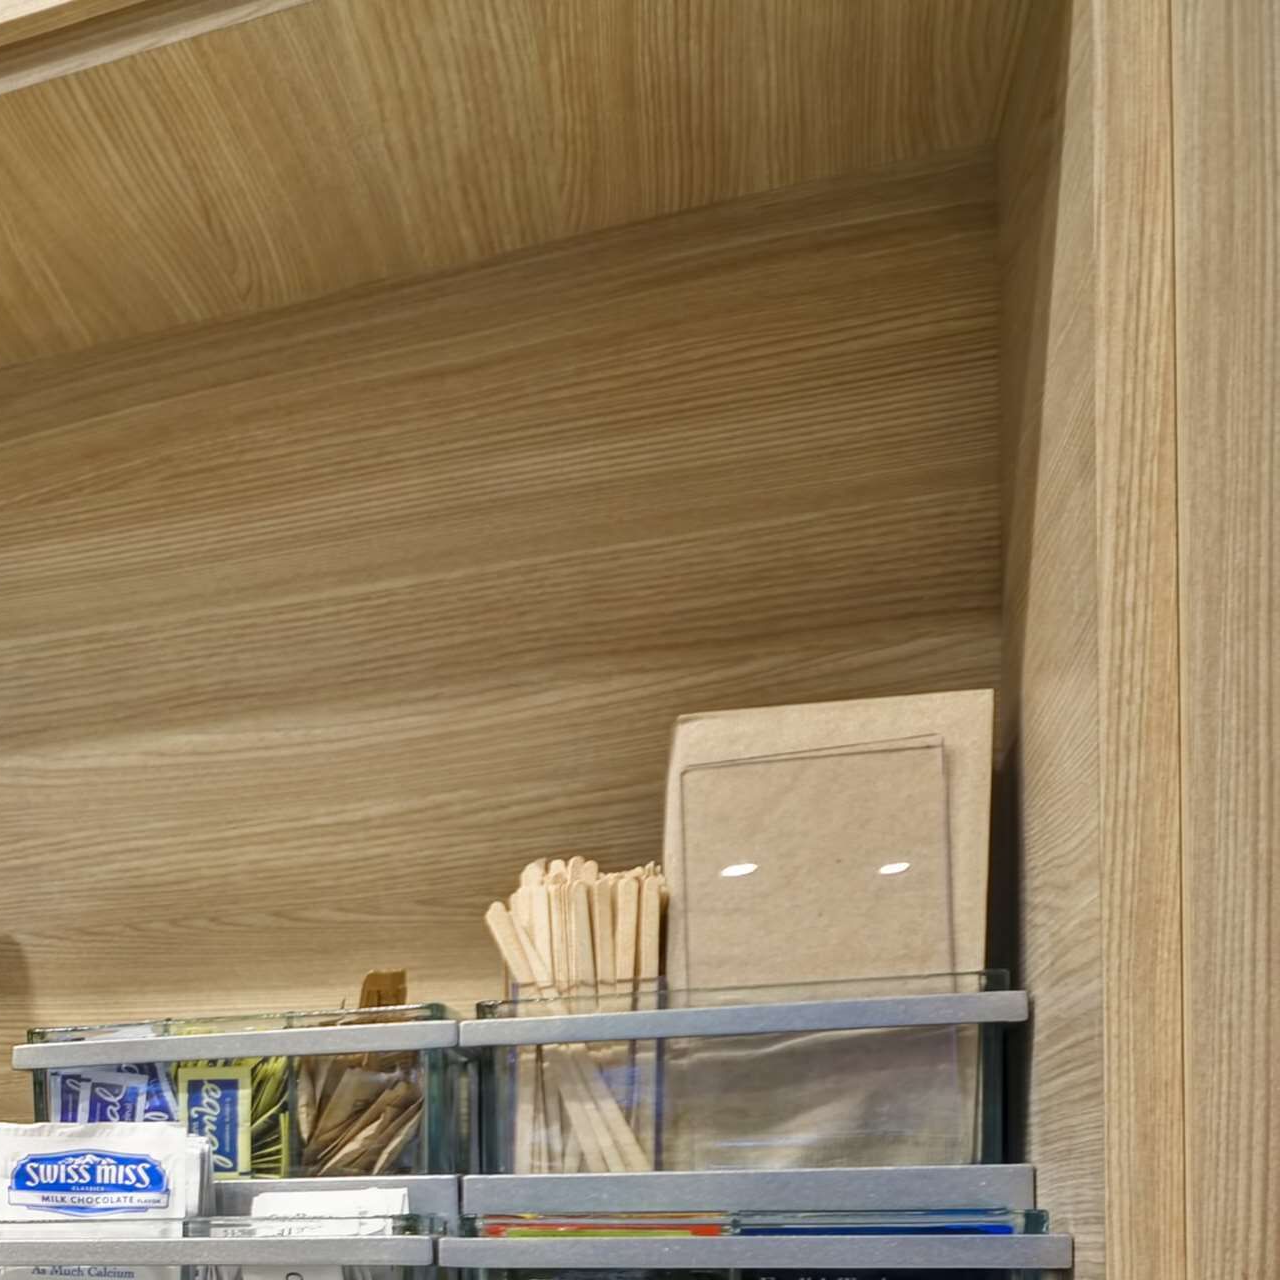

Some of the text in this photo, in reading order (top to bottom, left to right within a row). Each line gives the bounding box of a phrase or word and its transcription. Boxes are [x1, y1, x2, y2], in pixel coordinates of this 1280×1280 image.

[41, 1195, 66, 1204] MILK
[70, 1195, 134, 1204] CHOCOLATE
[31, 1266, 135, 1279] As Much Calcium
